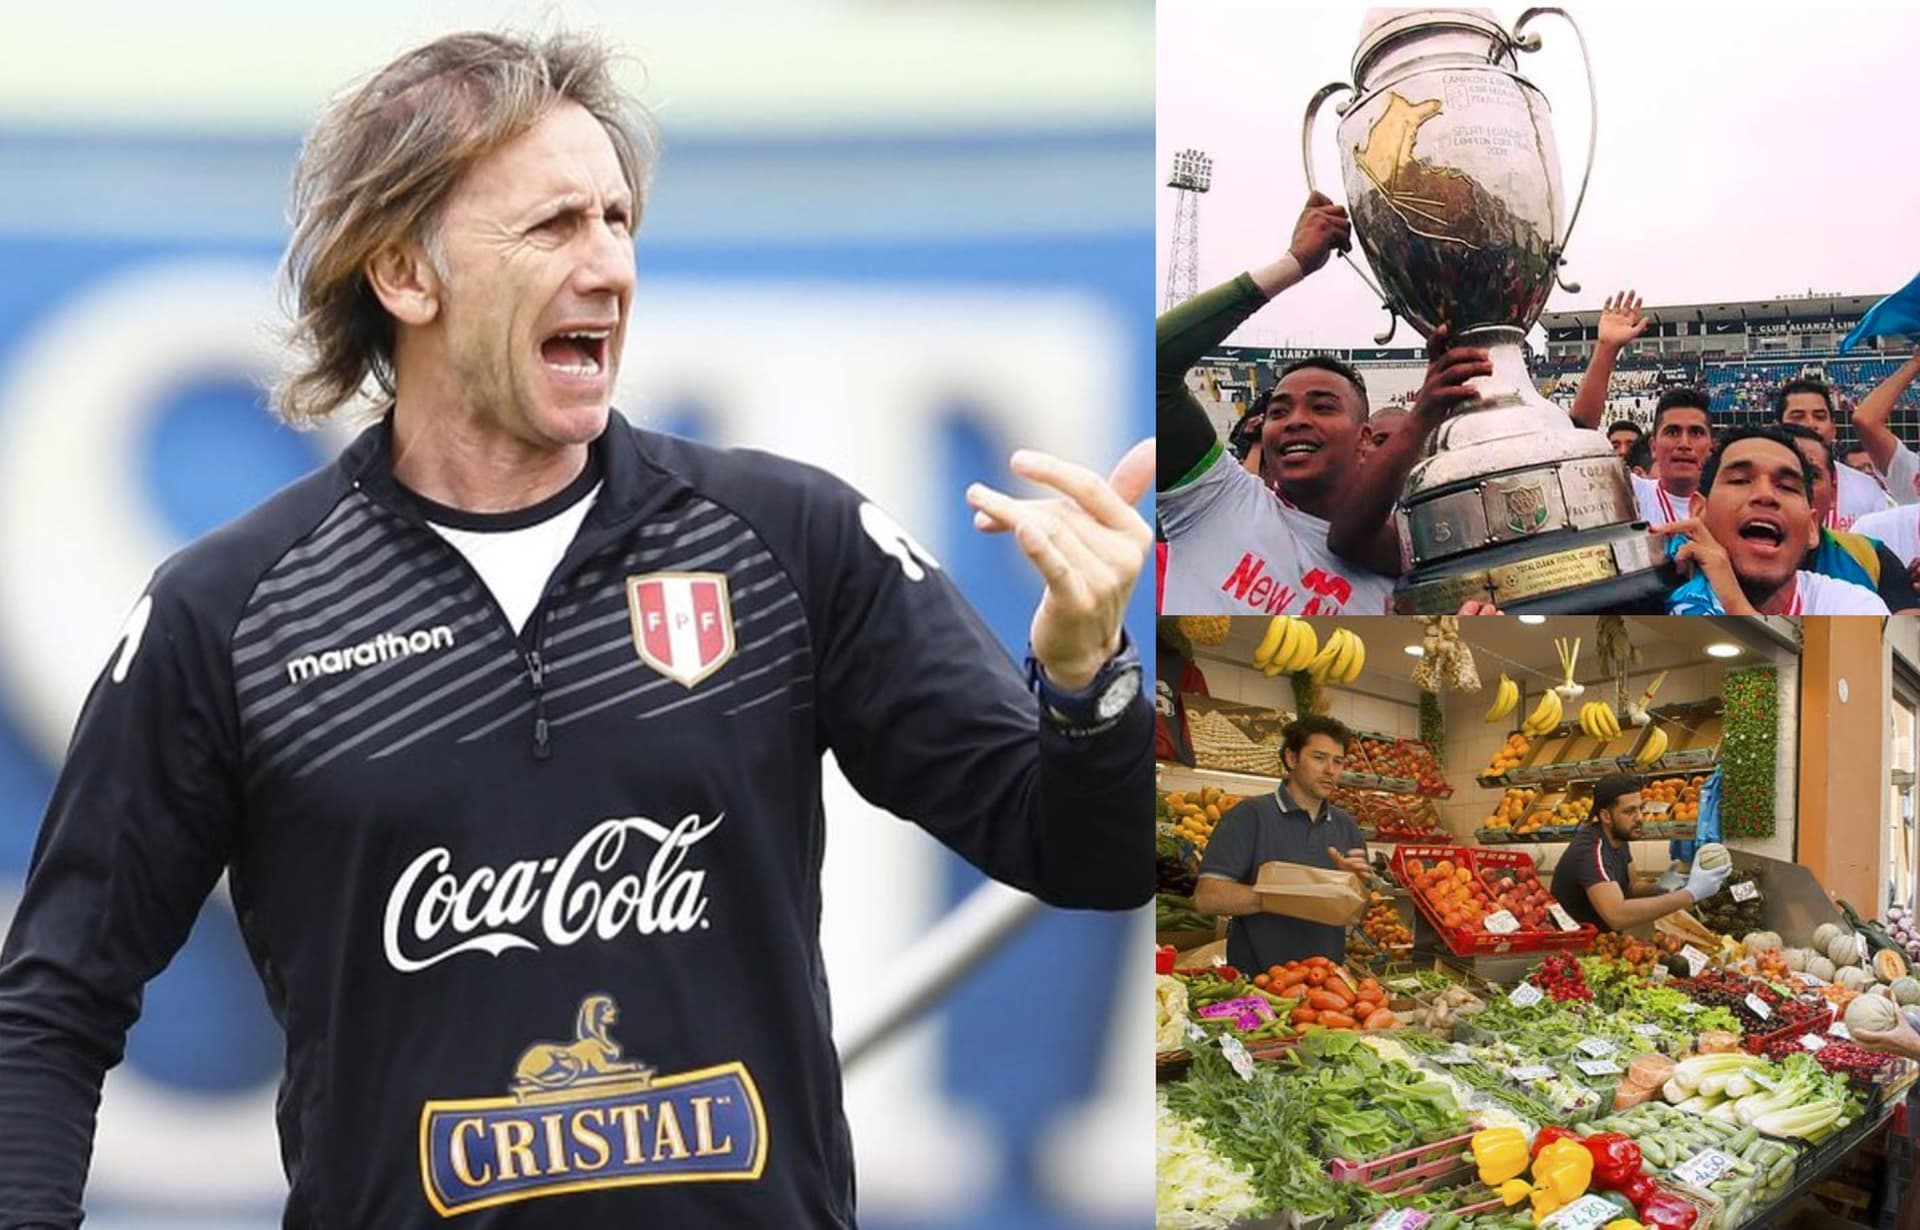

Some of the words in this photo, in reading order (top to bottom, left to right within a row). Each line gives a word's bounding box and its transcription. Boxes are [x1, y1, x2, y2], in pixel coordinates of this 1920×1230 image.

[1269, 349, 1315, 360] ALIANZA
[1759, 324, 1787, 333] CLUB
[1789, 322, 1834, 331] ALIANZA
[1837, 320, 1862, 330] LIM
[1222, 551, 1296, 615] New
[286, 623, 455, 685] marathon
[449, 1095, 733, 1188] CRISTAL
